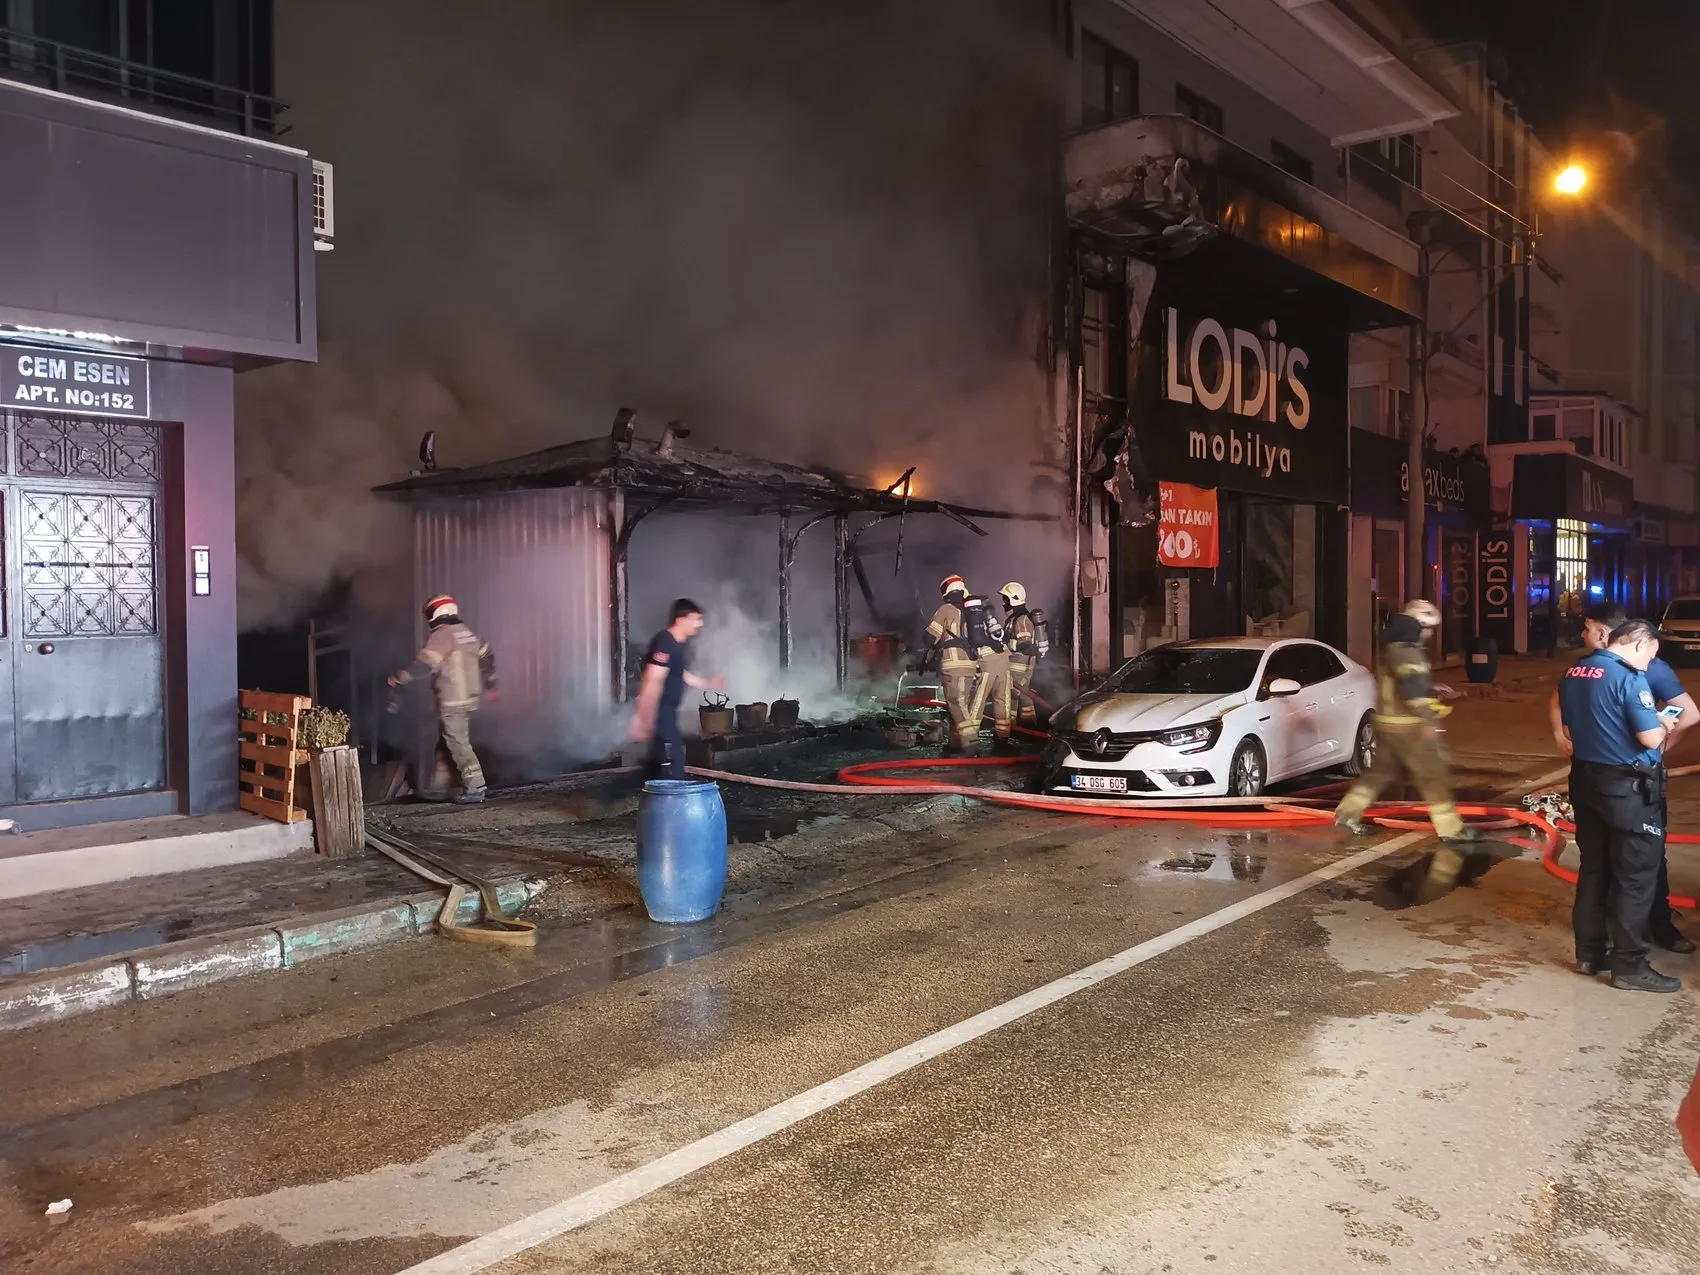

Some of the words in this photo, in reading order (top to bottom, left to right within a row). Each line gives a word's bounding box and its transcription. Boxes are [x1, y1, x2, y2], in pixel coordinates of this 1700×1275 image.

[17, 355, 67, 380] CEM
[73, 360, 130, 386] ESEN
[15, 384, 59, 403] APT.
[65, 388, 134, 410] NO:152
[1189, 429, 1291, 478] mobilya
[1076, 776, 1086, 787] 34
[1109, 778, 1126, 789] 605
